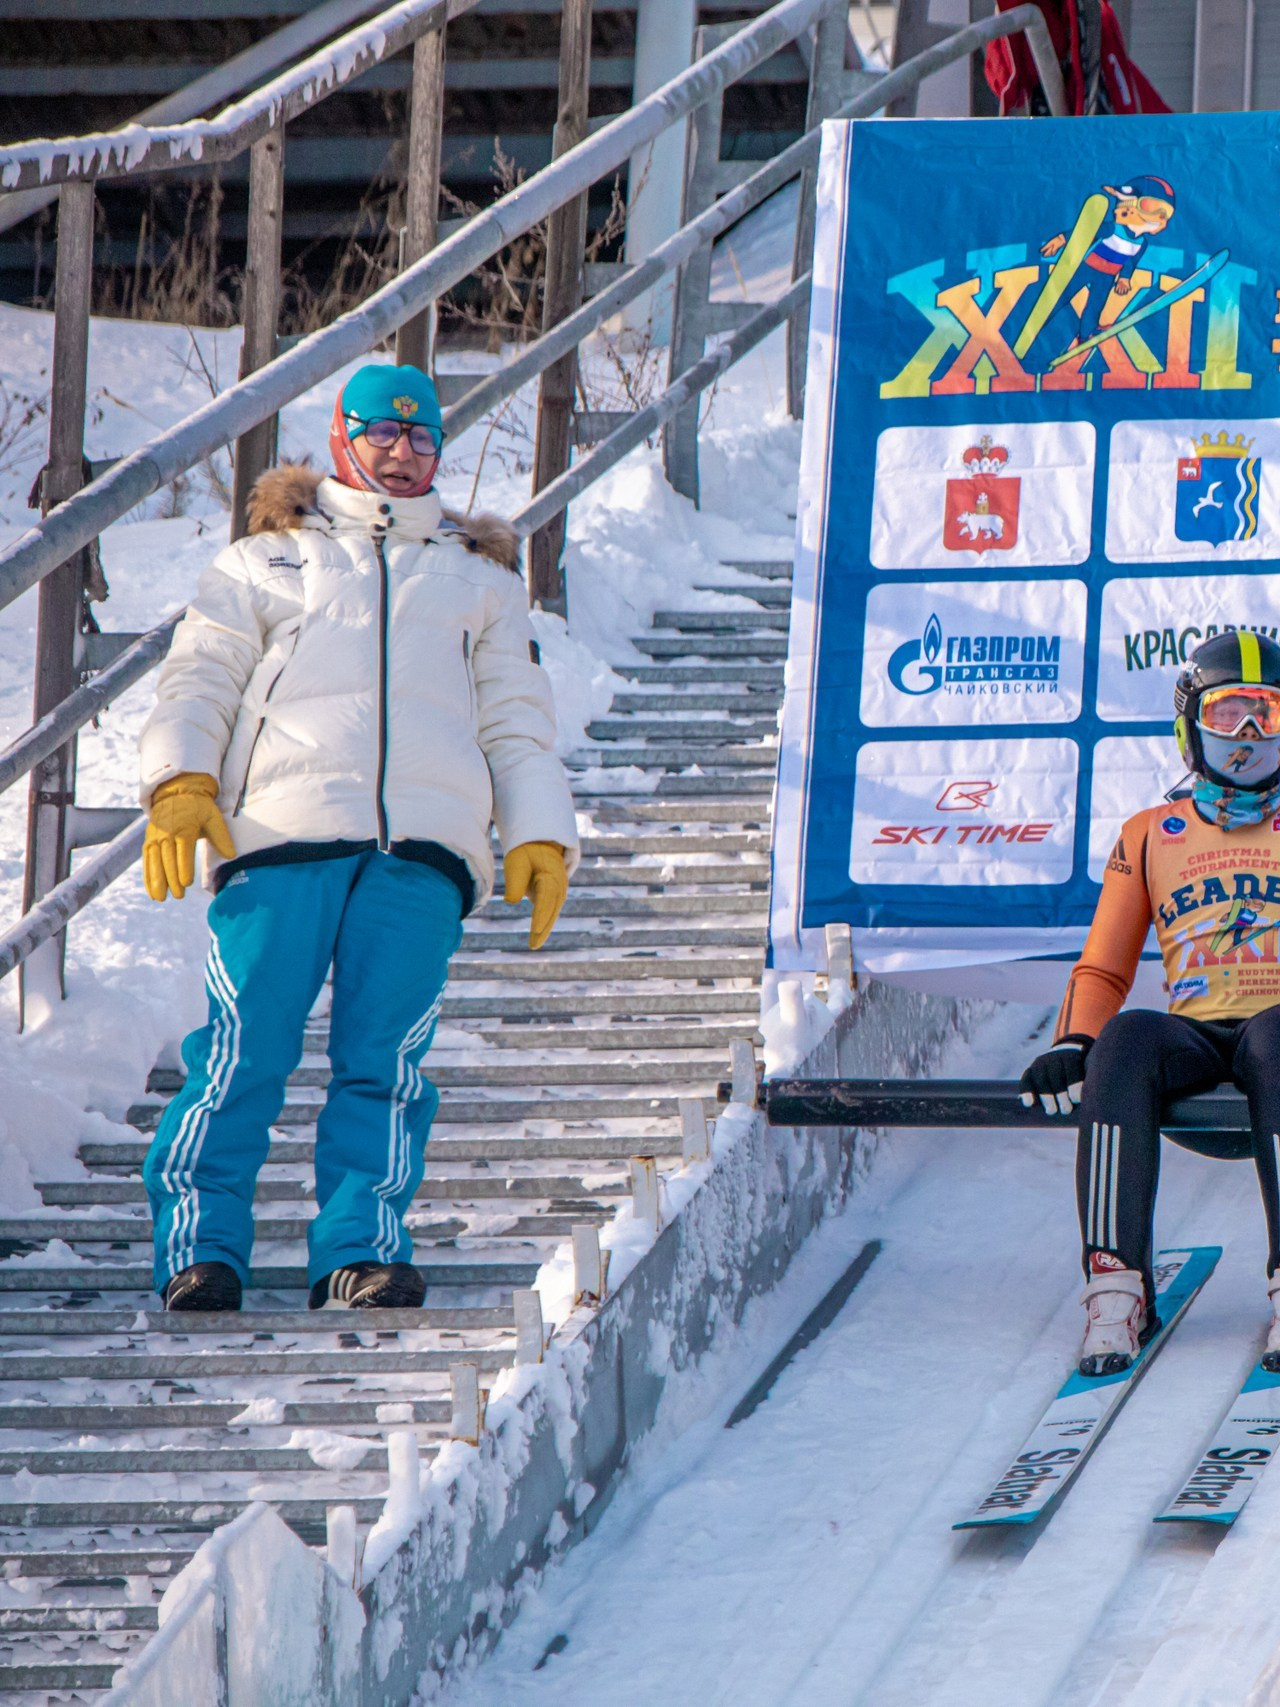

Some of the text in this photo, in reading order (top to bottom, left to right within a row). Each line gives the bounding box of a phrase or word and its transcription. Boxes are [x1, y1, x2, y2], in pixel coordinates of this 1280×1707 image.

[946, 635, 1061, 663] ГАЗПРОМ
[949, 667, 1055, 679] ТРАНСГАЗ
[944, 681, 1058, 696] ЧАЙКОВСКИЙ
[871, 823, 1053, 845] SKI TIME
[1187, 848, 1271, 866] CHRISTMAS
[1179, 858, 1280, 881] TOURNAMENT
[978, 1447, 1081, 1510] Slatnar
[1173, 1447, 1272, 1508] Slatnar
